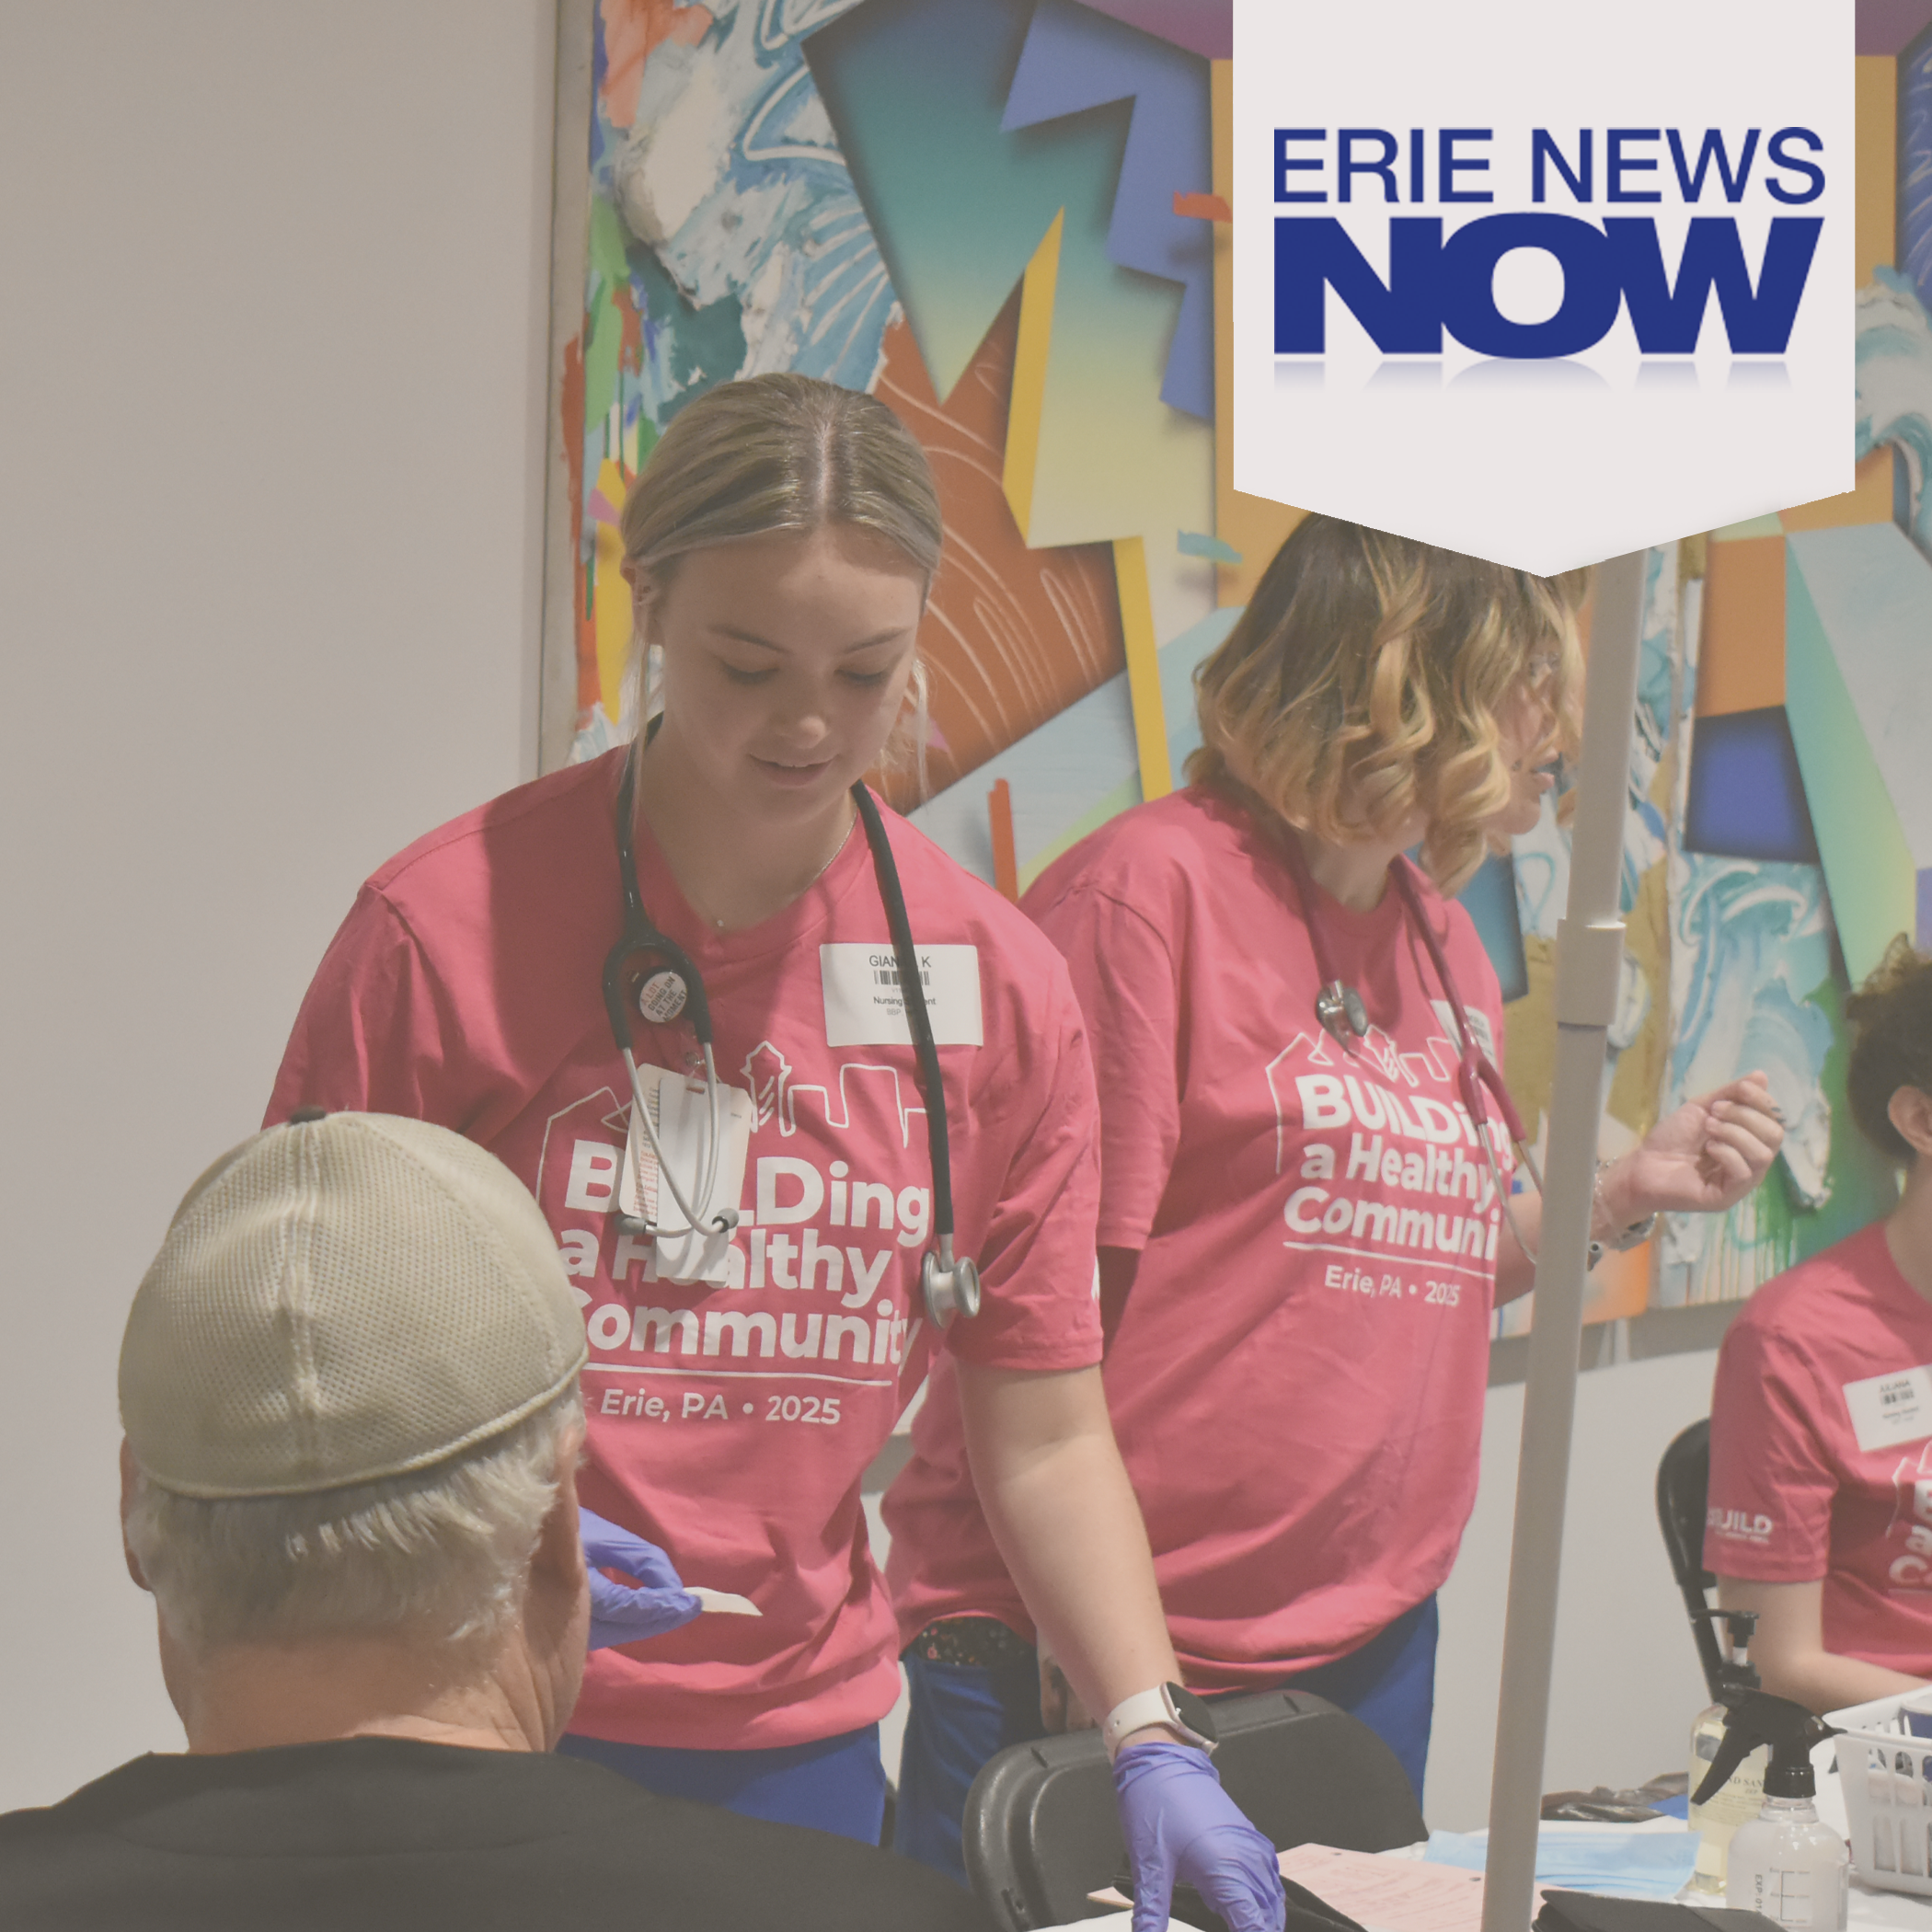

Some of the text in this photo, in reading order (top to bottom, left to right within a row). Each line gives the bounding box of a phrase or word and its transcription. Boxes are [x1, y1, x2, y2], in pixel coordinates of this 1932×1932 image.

[921, 956, 932, 968] K
[648, 975, 676, 1011] GOING ON
[655, 989, 677, 1017] AT THE
[873, 996, 903, 1007] Nursing
[1300, 1132, 1502, 1214] a Healthy
[558, 1228, 600, 1278] a
[612, 1227, 893, 1308] Halthy
[1325, 1264, 1375, 1298] Erie,
[1379, 1273, 1401, 1298] PA
[570, 1286, 924, 1377] ommunity
[600, 1388, 841, 1425] Erie, PA 2025
